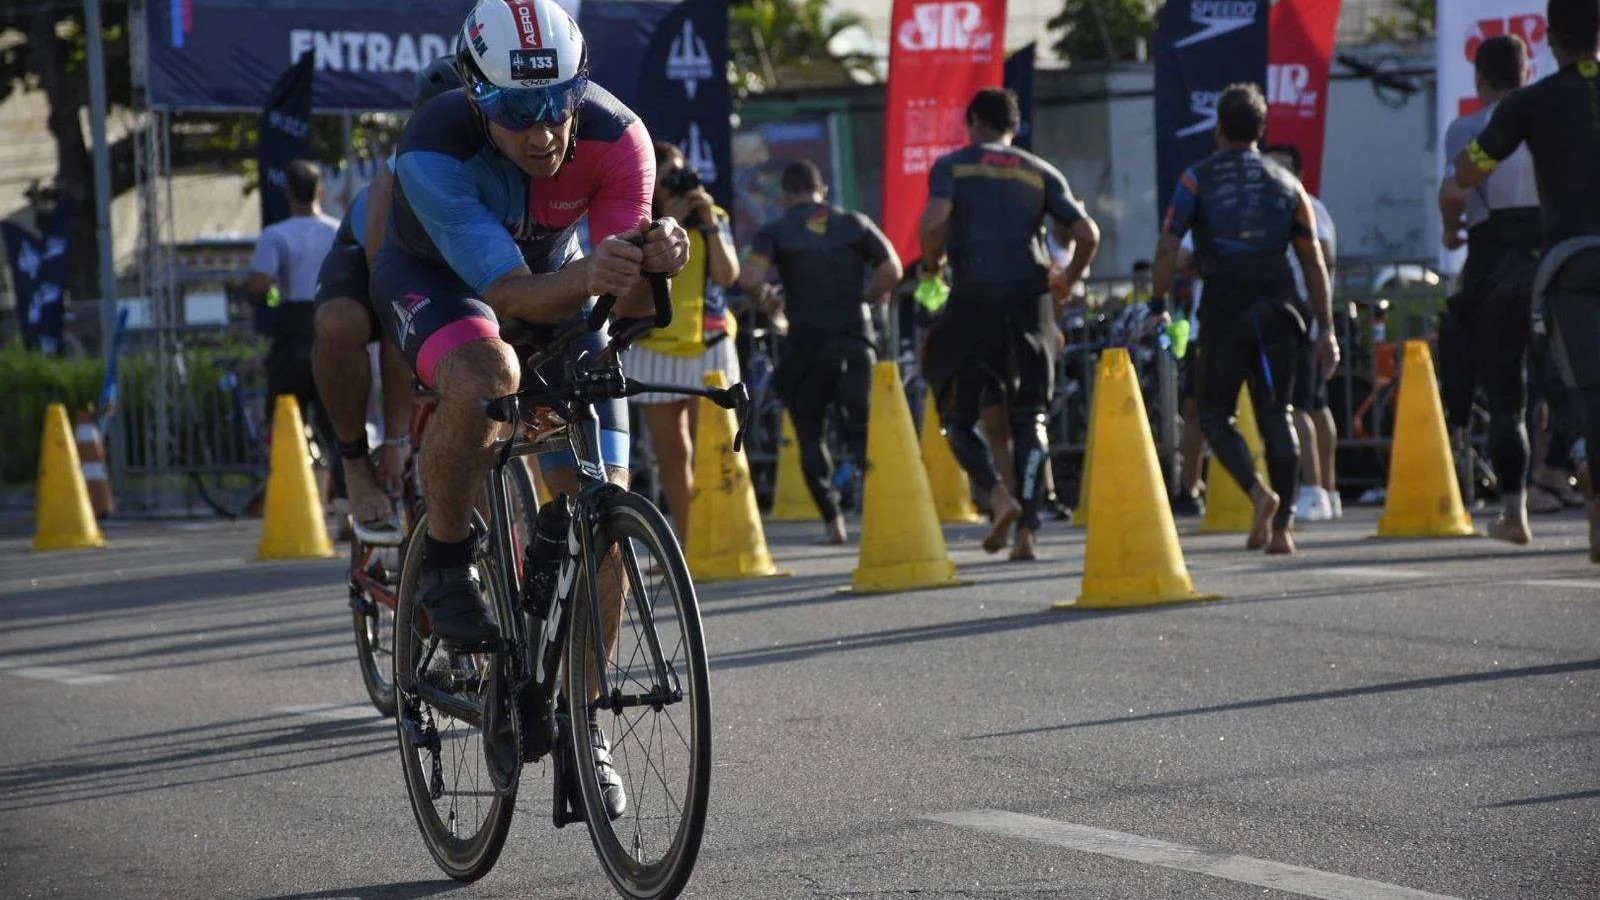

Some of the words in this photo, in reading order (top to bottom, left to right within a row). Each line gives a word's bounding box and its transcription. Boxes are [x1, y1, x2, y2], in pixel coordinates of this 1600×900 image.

[1190, 1, 1257, 18] SPEEDO
[519, 6, 537, 46] AERO
[290, 29, 457, 74] ENTRAD
[529, 56, 553, 69] 133
